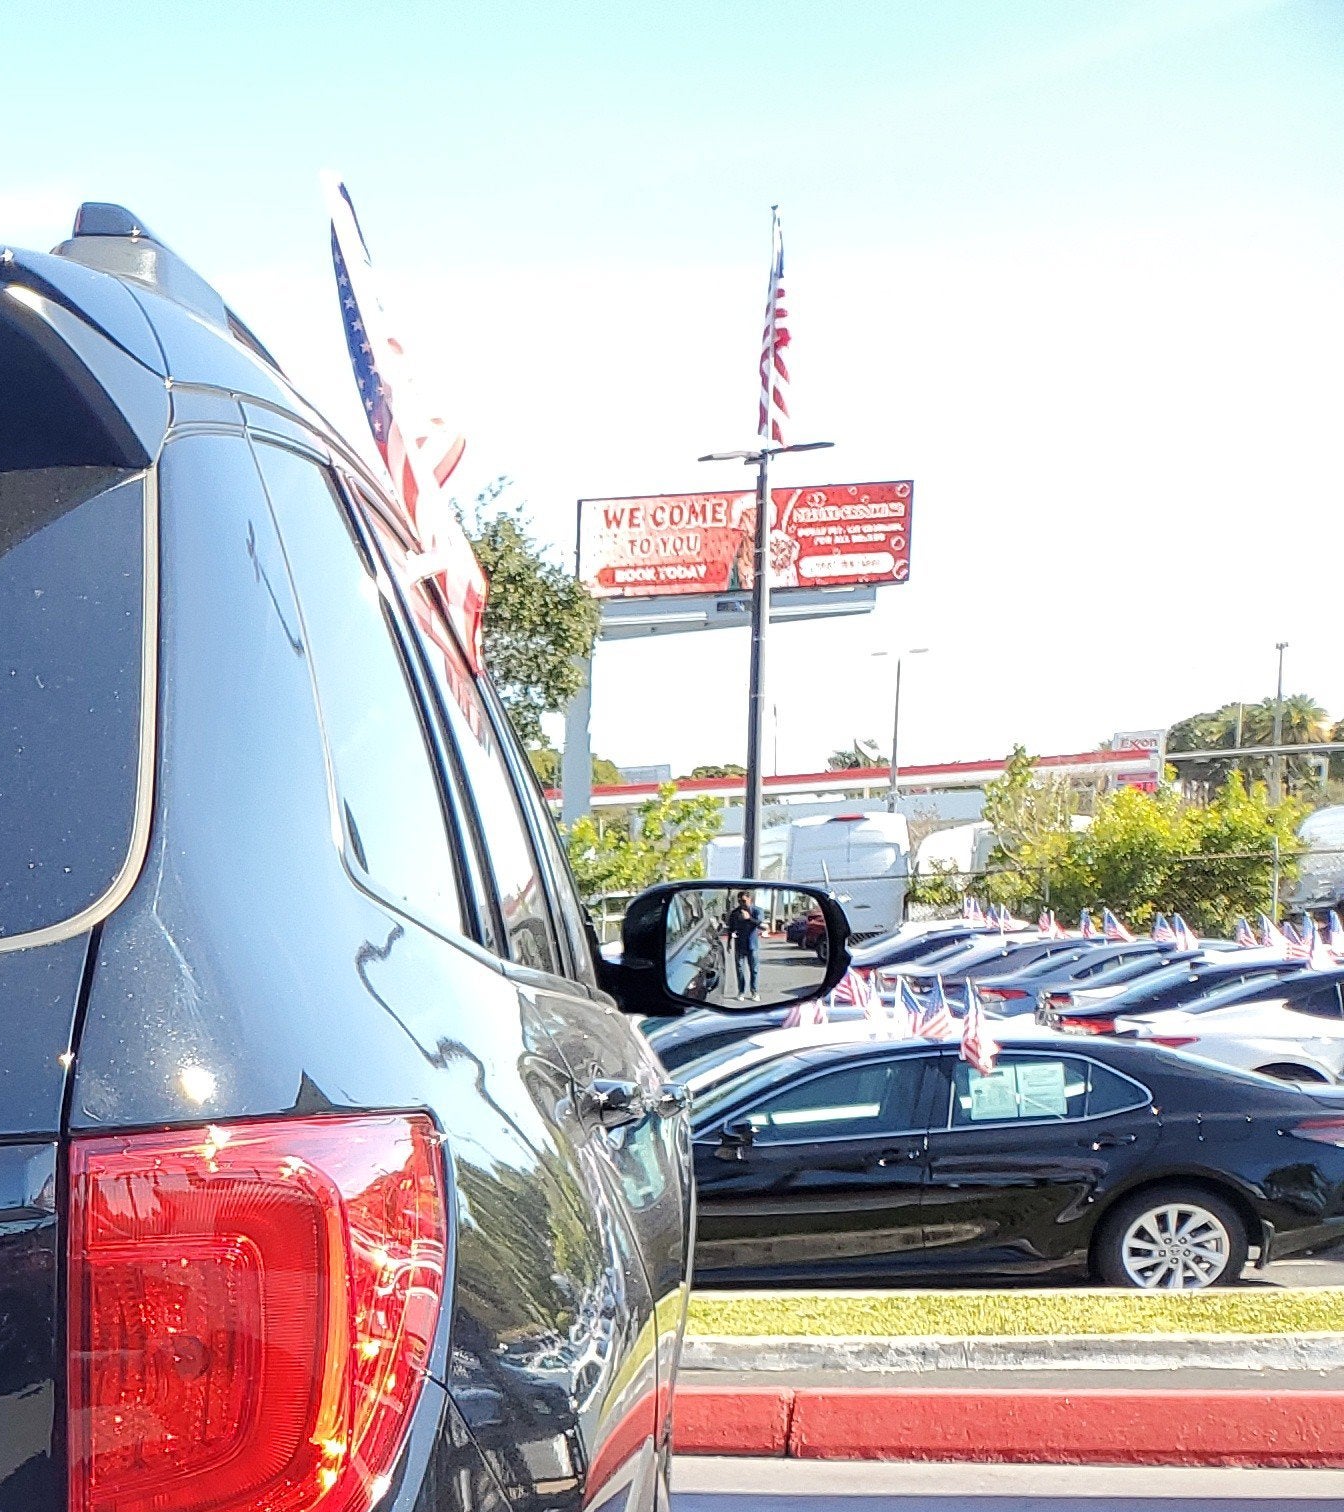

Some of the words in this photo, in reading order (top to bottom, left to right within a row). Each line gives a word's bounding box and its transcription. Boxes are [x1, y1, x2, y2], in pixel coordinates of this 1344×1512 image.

[603, 506, 641, 529] WE
[650, 501, 724, 530] COME
[627, 538, 651, 554] TO
[660, 535, 698, 554] YOU
